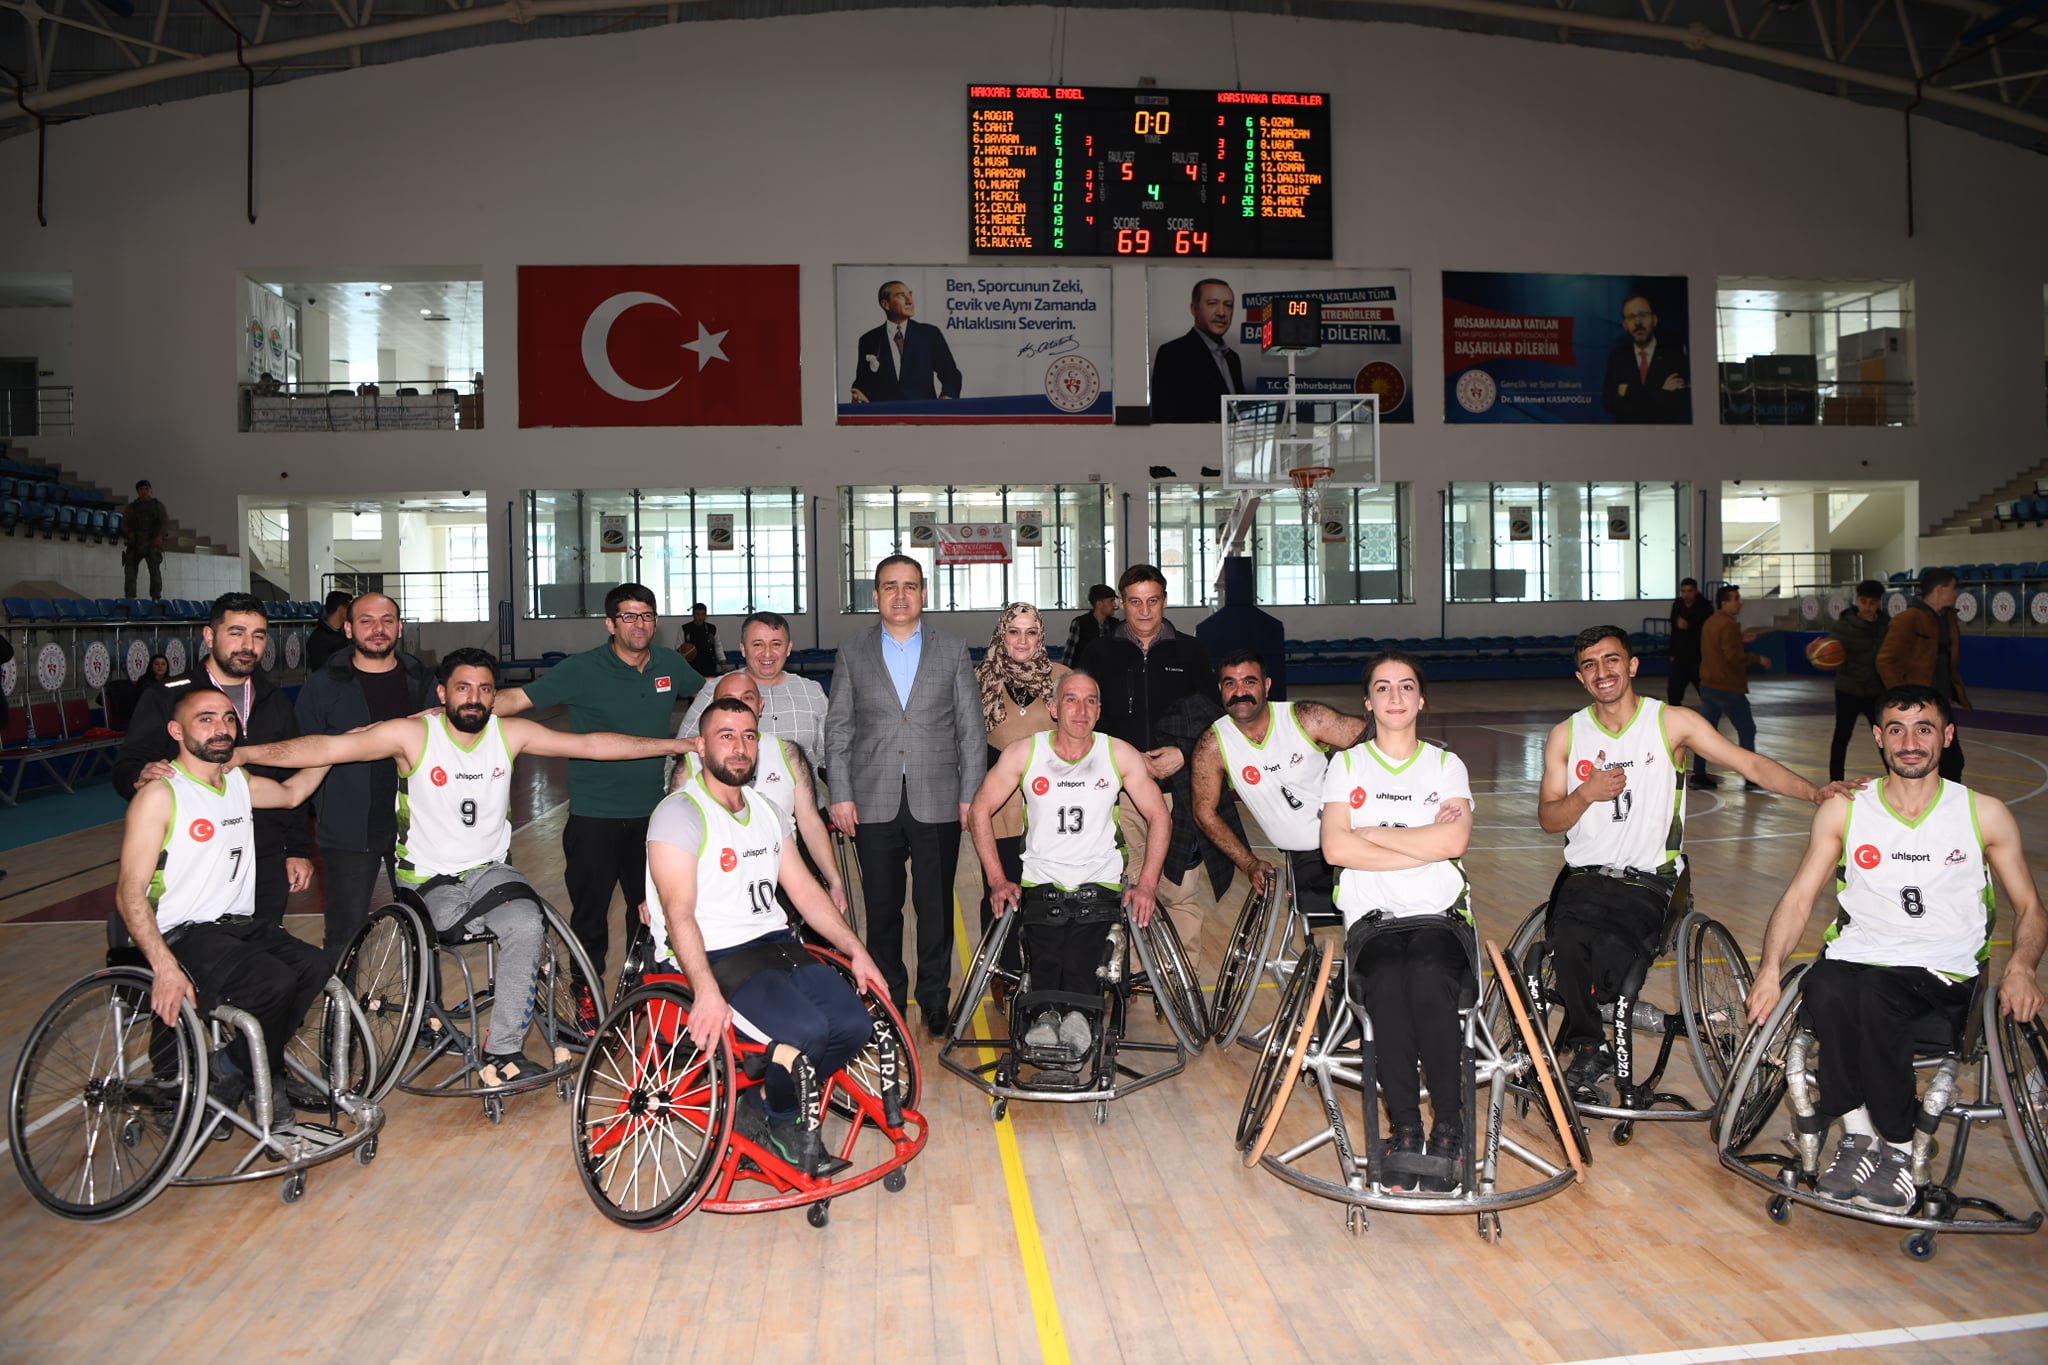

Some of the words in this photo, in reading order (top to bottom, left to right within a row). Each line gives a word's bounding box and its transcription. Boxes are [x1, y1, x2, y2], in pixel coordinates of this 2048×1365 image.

[1016, 87, 1050, 99] SÜMBÜL
[1055, 88, 1085, 99] ENGEL
[1054, 113, 1062, 122] 4
[1134, 110, 1170, 135] 0:0
[1217, 116, 1224, 126] 3
[1246, 117, 1253, 127] 6
[1054, 124, 1062, 134] 5
[1247, 128, 1253, 137] 7
[1260, 128, 1310, 139] 7.RAMAZAN
[973, 134, 1020, 144] 6.BAYRAM
[1054, 136, 1062, 146] 6
[1085, 136, 1092, 146] 3
[1144, 135, 1162, 144] TIME
[1218, 138, 1225, 148] 3
[1246, 139, 1253, 149] 8
[1056, 147, 1062, 157] 7
[1108, 151, 1135, 162] FAUL/SET
[1172, 152, 1199, 163] FAUL/SET
[1218, 150, 1225, 160] 2
[1246, 150, 1254, 161] 9
[1260, 151, 1304, 162] 9.VEYSEL
[973, 157, 1009, 167] 8.MUSA
[1055, 158, 1063, 168] 8
[1245, 162, 1254, 172] 12
[1260, 162, 1305, 172] 12.OSMAN
[973, 168, 1026, 179] 9.RAMAZAN
[1056, 170, 1063, 180] 9
[1085, 170, 1092, 180] 3
[1121, 162, 1133, 180] 5
[1185, 164, 1198, 181] 4
[1218, 172, 1225, 182] 2
[1245, 174, 1254, 183] 13
[974, 180, 1020, 190] 10.MURAT
[1053, 182, 1063, 191] 10
[1086, 182, 1092, 191] 4
[1245, 185, 1254, 194] 17
[1053, 193, 1063, 202] 11
[1085, 192, 1093, 203] 2
[1148, 184, 1159, 200] 4
[1142, 202, 1164, 210] PERIOD
[1242, 196, 1254, 206] 26
[1261, 196, 1306, 206] 26.AHMET
[974, 203, 1026, 213] 12.CEYLAN
[1054, 204, 1063, 214] 12
[1242, 207, 1254, 217] 35
[1261, 207, 1306, 218] 35.ERDAL
[974, 214, 1026, 224] 13.MEHMET
[1086, 216, 1093, 224] 4
[1113, 217, 1140, 230] SCORE
[1167, 218, 1194, 231] SCORE
[1054, 227, 1063, 236] 14
[1054, 238, 1063, 248] 15
[1117, 230, 1150, 254] 69
[1176, 230, 1207, 254] 64
[946, 279, 975, 294] Ben,
[978, 279, 1050, 295] Sporcunun
[1052, 280, 1083, 294] Zeki,
[1326, 291, 1366, 302] KATILAN
[1368, 289, 1390, 299] TÜM
[946, 297, 982, 315] Çevik
[984, 301, 1000, 311] ve
[1002, 299, 1032, 315] Aynı
[1034, 298, 1096, 312] Zamanda
[1288, 301, 1308, 316] 0:0
[946, 316, 1016, 330] Ahlaklısını
[1018, 316, 1076, 330] Severim.
[1454, 316, 1522, 330] MÜSABAKALARA
[1524, 318, 1558, 330] KATILAN
[1328, 324, 1390, 341] DİLERİM.
[1454, 342, 1512, 357] BAŞARILAR
[1515, 341, 1559, 355] DİLERİM
[1267, 381, 1282, 390] T.C.
[1284, 381, 1352, 391] Cmhurbaşkanı
[1540, 380, 1556, 390] Spor
[1501, 396, 1512, 404] Dr.
[1514, 396, 1545, 404] Mehmet
[1546, 395, 1592, 404] KASAPOĞLU
[455, 772, 484, 782] uhlsport
[1057, 780, 1085, 789] uhlsport
[1376, 792, 1412, 802] uhlsport
[460, 798, 478, 828] 9
[221, 816, 244, 826] uhlsport
[1057, 806, 1085, 834] 13
[742, 847, 767, 858] uhlsport
[1892, 852, 1930, 863] uhlsport
[229, 847, 243, 882] 7
[748, 878, 774, 914] 10
[1901, 886, 1926, 918] 8
